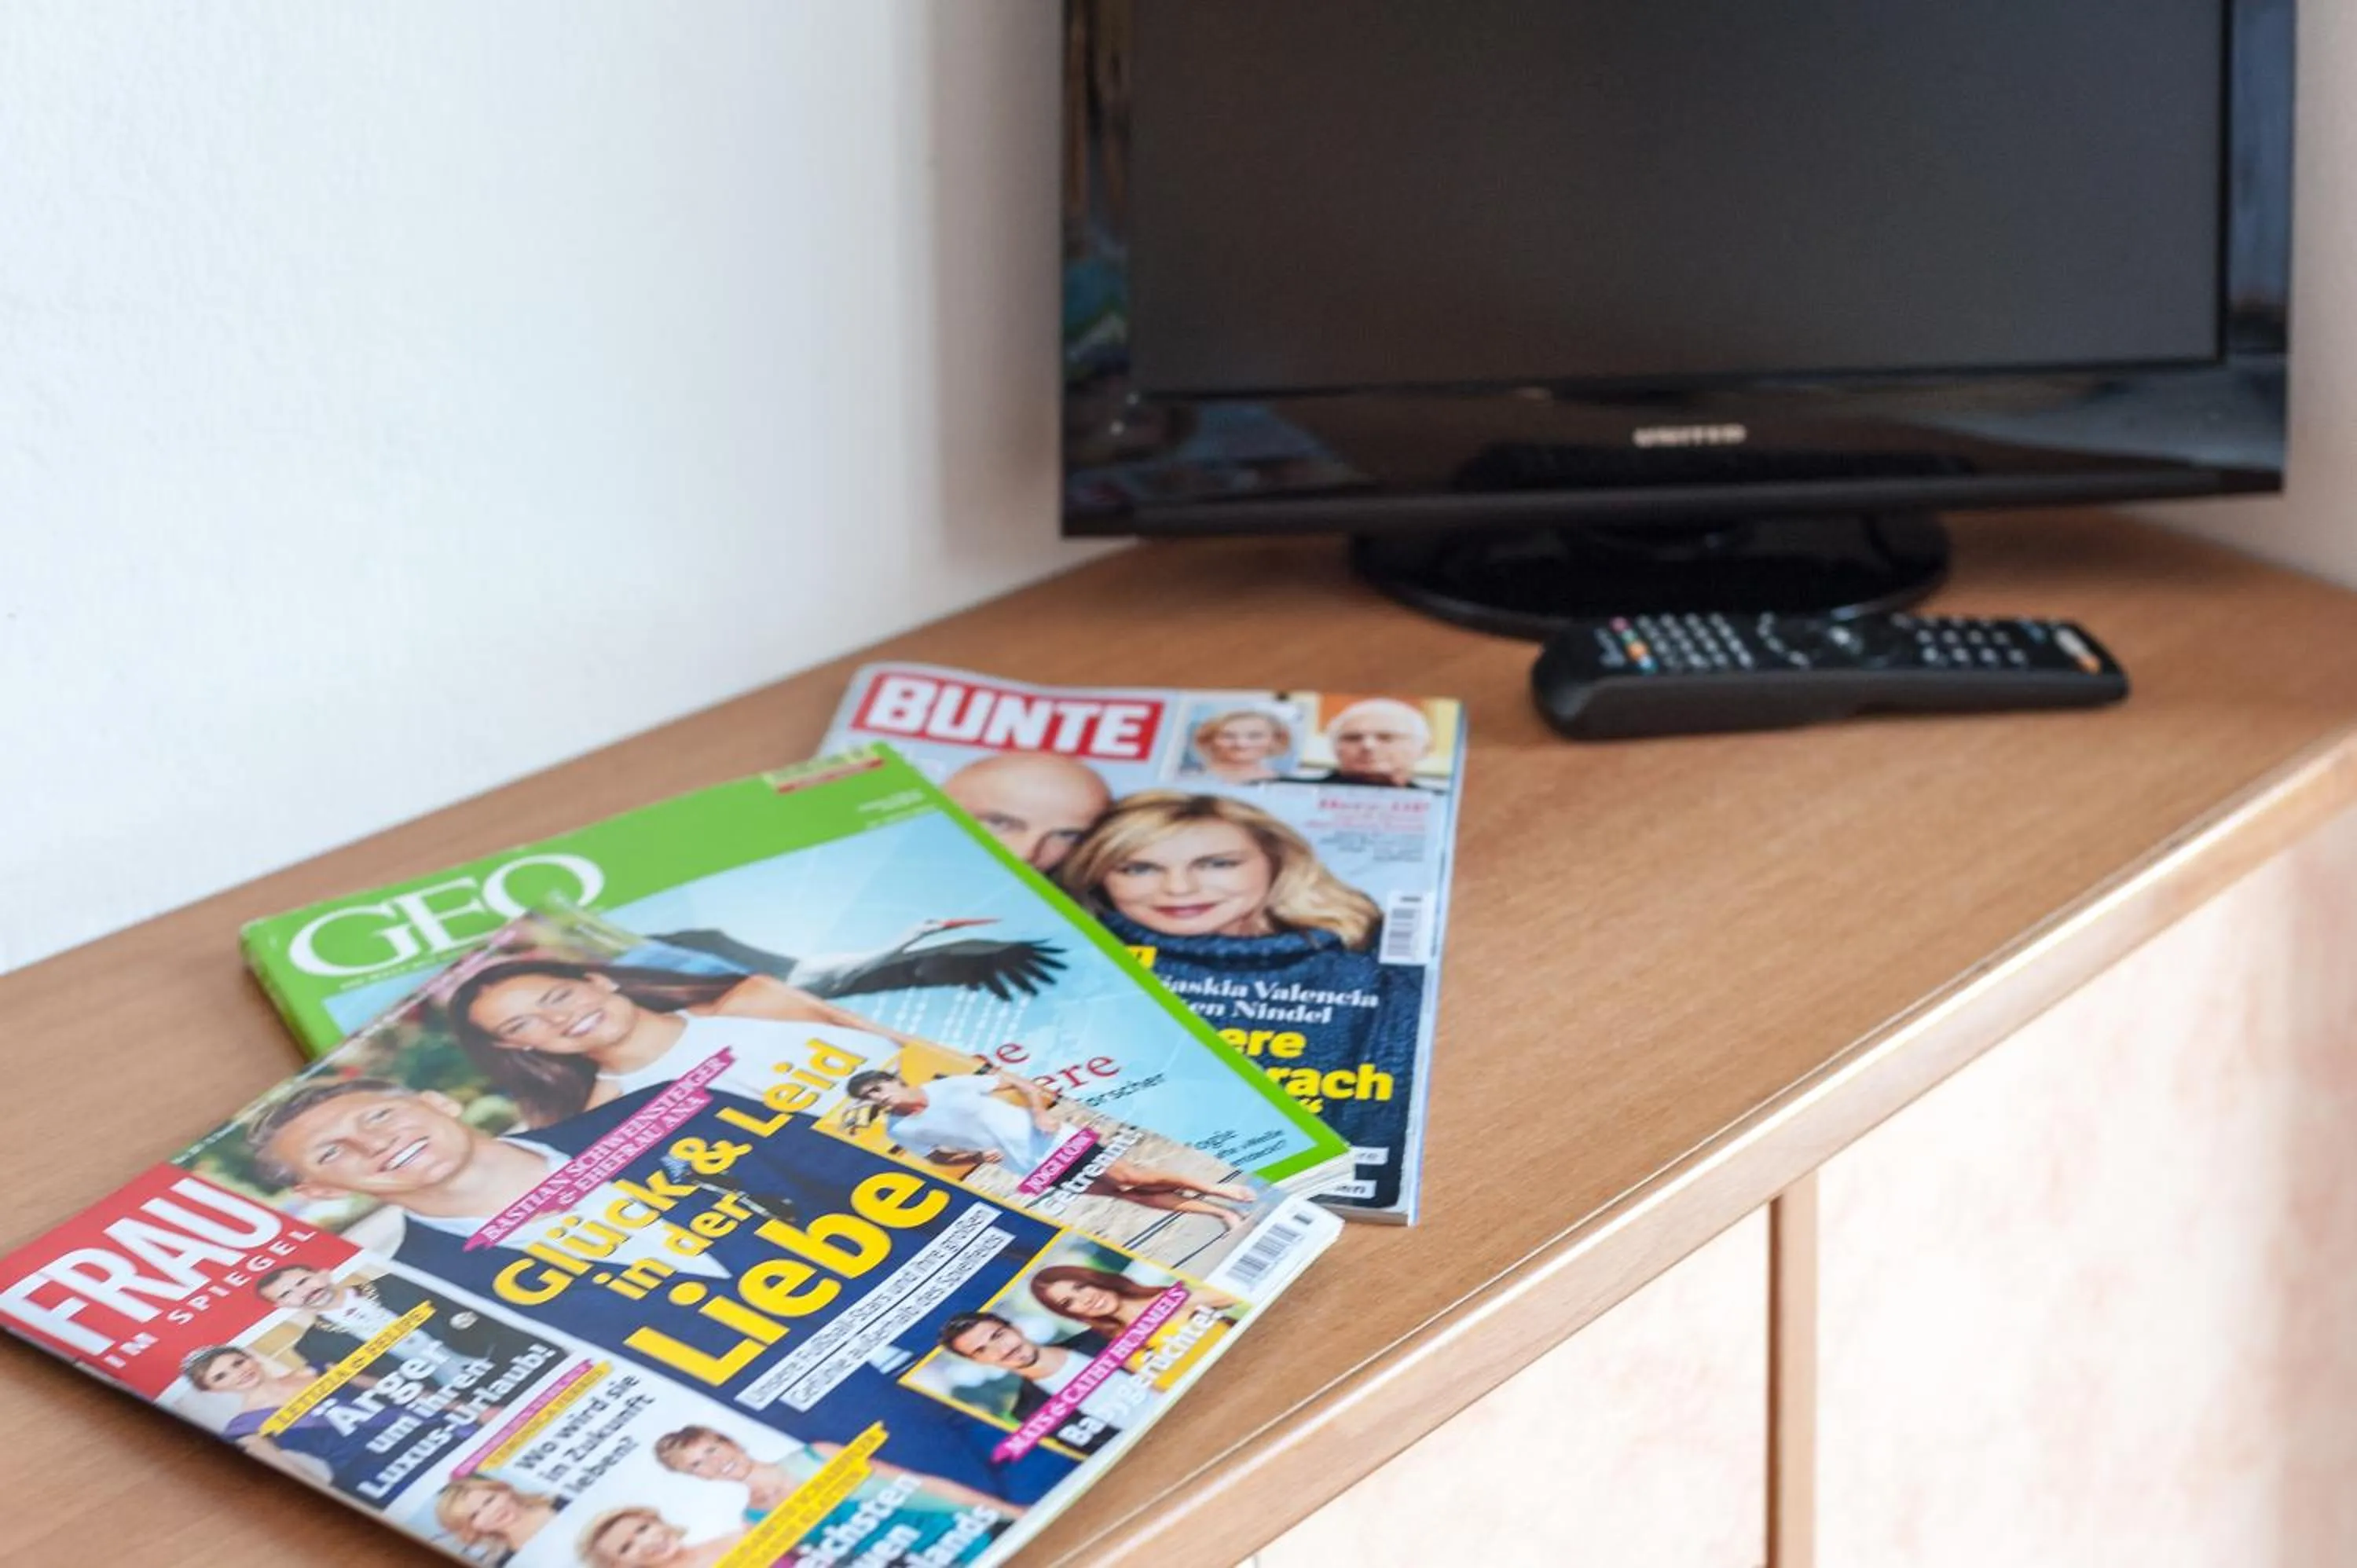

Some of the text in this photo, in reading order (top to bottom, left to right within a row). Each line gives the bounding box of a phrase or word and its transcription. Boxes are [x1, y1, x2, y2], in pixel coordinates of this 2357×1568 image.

[867, 676, 1151, 757] BUNTE
[288, 853, 605, 976] GEO
[1231, 1000, 1333, 1024] Nindel
[1255, 980, 1380, 1009] Valencia
[1074, 1072, 1166, 1108] orscher
[493, 1037, 867, 1306] Glück & Leid
[574, 1123, 665, 1191] EHEFRAU
[666, 1094, 709, 1129] ANA
[482, 1174, 572, 1241] BASTIAN
[592, 1190, 755, 1300] in der
[0, 1177, 283, 1357] FRAU
[102, 1229, 317, 1368] IM SPIEGEL
[623, 1171, 951, 1387] Liebe
[312, 1339, 452, 1438] Ärger
[356, 1343, 556, 1499] Luxus-Urlaub!
[365, 1416, 423, 1453] um
[405, 1357, 496, 1419] ihren
[515, 1375, 640, 1470] Wo wird sie
[537, 1394, 656, 1483] in Zukunft
[563, 1435, 640, 1493] leben?
